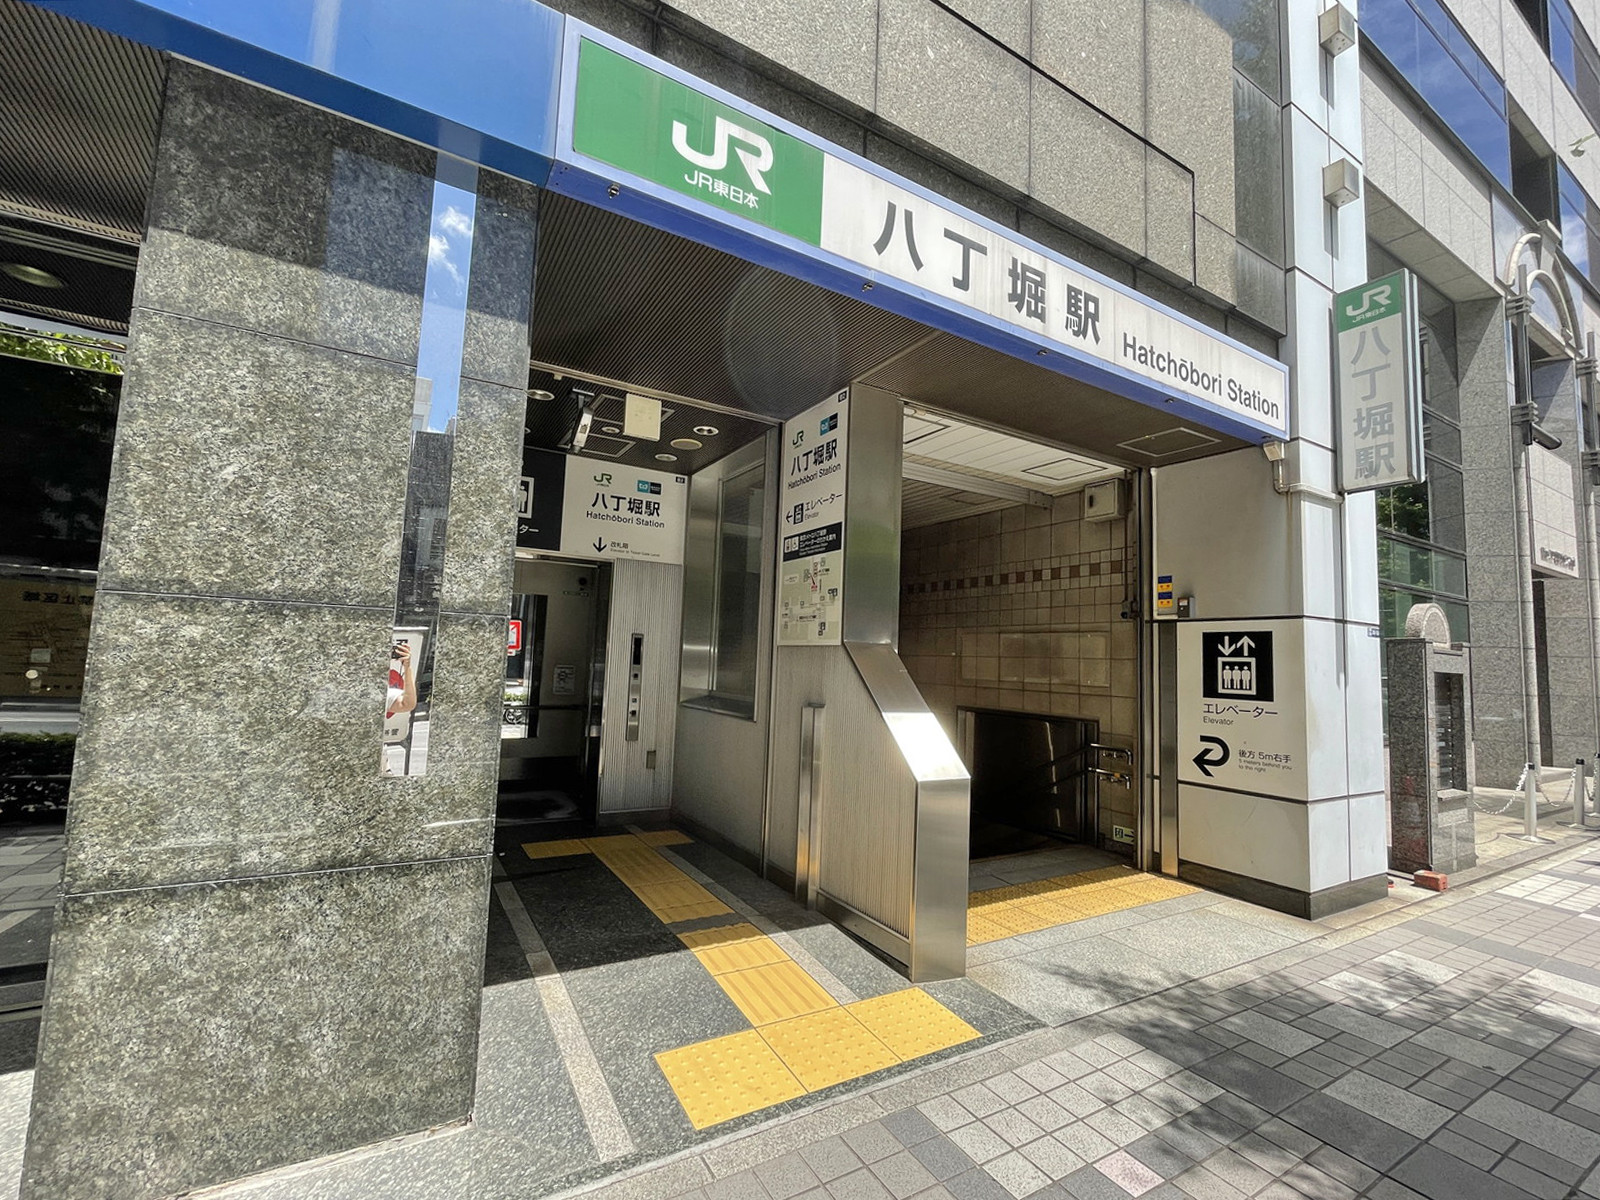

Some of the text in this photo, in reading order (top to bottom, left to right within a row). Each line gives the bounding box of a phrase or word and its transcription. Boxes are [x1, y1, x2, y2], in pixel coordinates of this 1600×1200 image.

[672, 115, 773, 195] JR
[684, 170, 759, 209] JR東日本
[873, 200, 1101, 345] 八丁堀駅
[1346, 285, 1392, 316] JR
[1123, 332, 1279, 419] Hatchōbori Station
[1351, 326, 1396, 480] 八丁堀駅
[792, 430, 804, 446] JR
[791, 438, 837, 476] 八丁堀駅
[593, 473, 613, 485] JR
[819, 463, 841, 478] Station
[592, 492, 661, 517] 八丁堀駅
[804, 493, 843, 511] エレベーター
[636, 517, 665, 528] Station
[1203, 703, 1278, 718] エレベーター
[1203, 716, 1234, 726] Elevator
